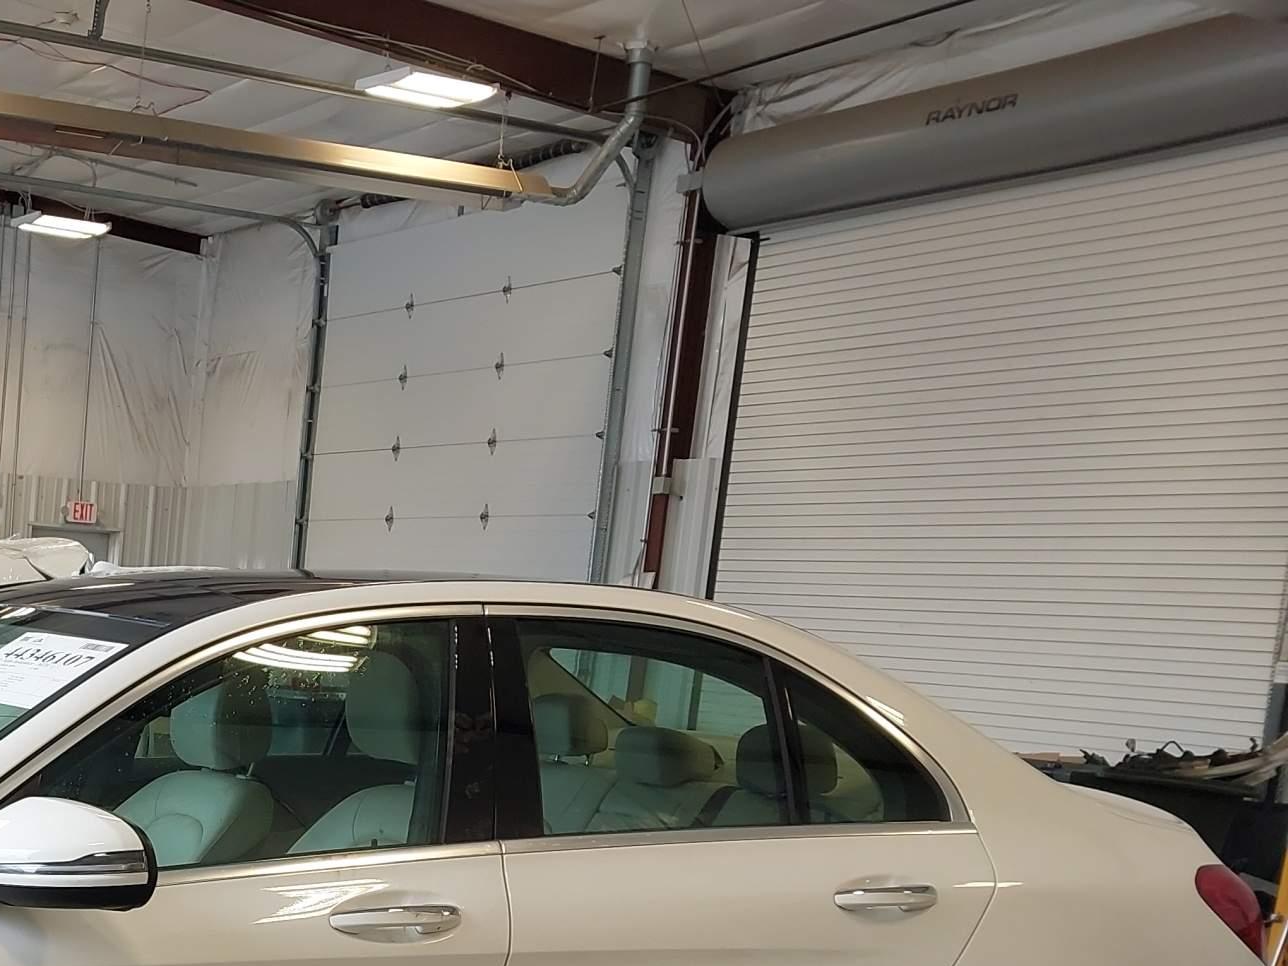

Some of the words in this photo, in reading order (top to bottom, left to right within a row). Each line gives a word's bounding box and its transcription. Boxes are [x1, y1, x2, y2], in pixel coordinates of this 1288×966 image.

[925, 93, 1019, 126] RAYNOR
[73, 502, 95, 521] EXIT
[3, 646, 96, 668] 44346107
